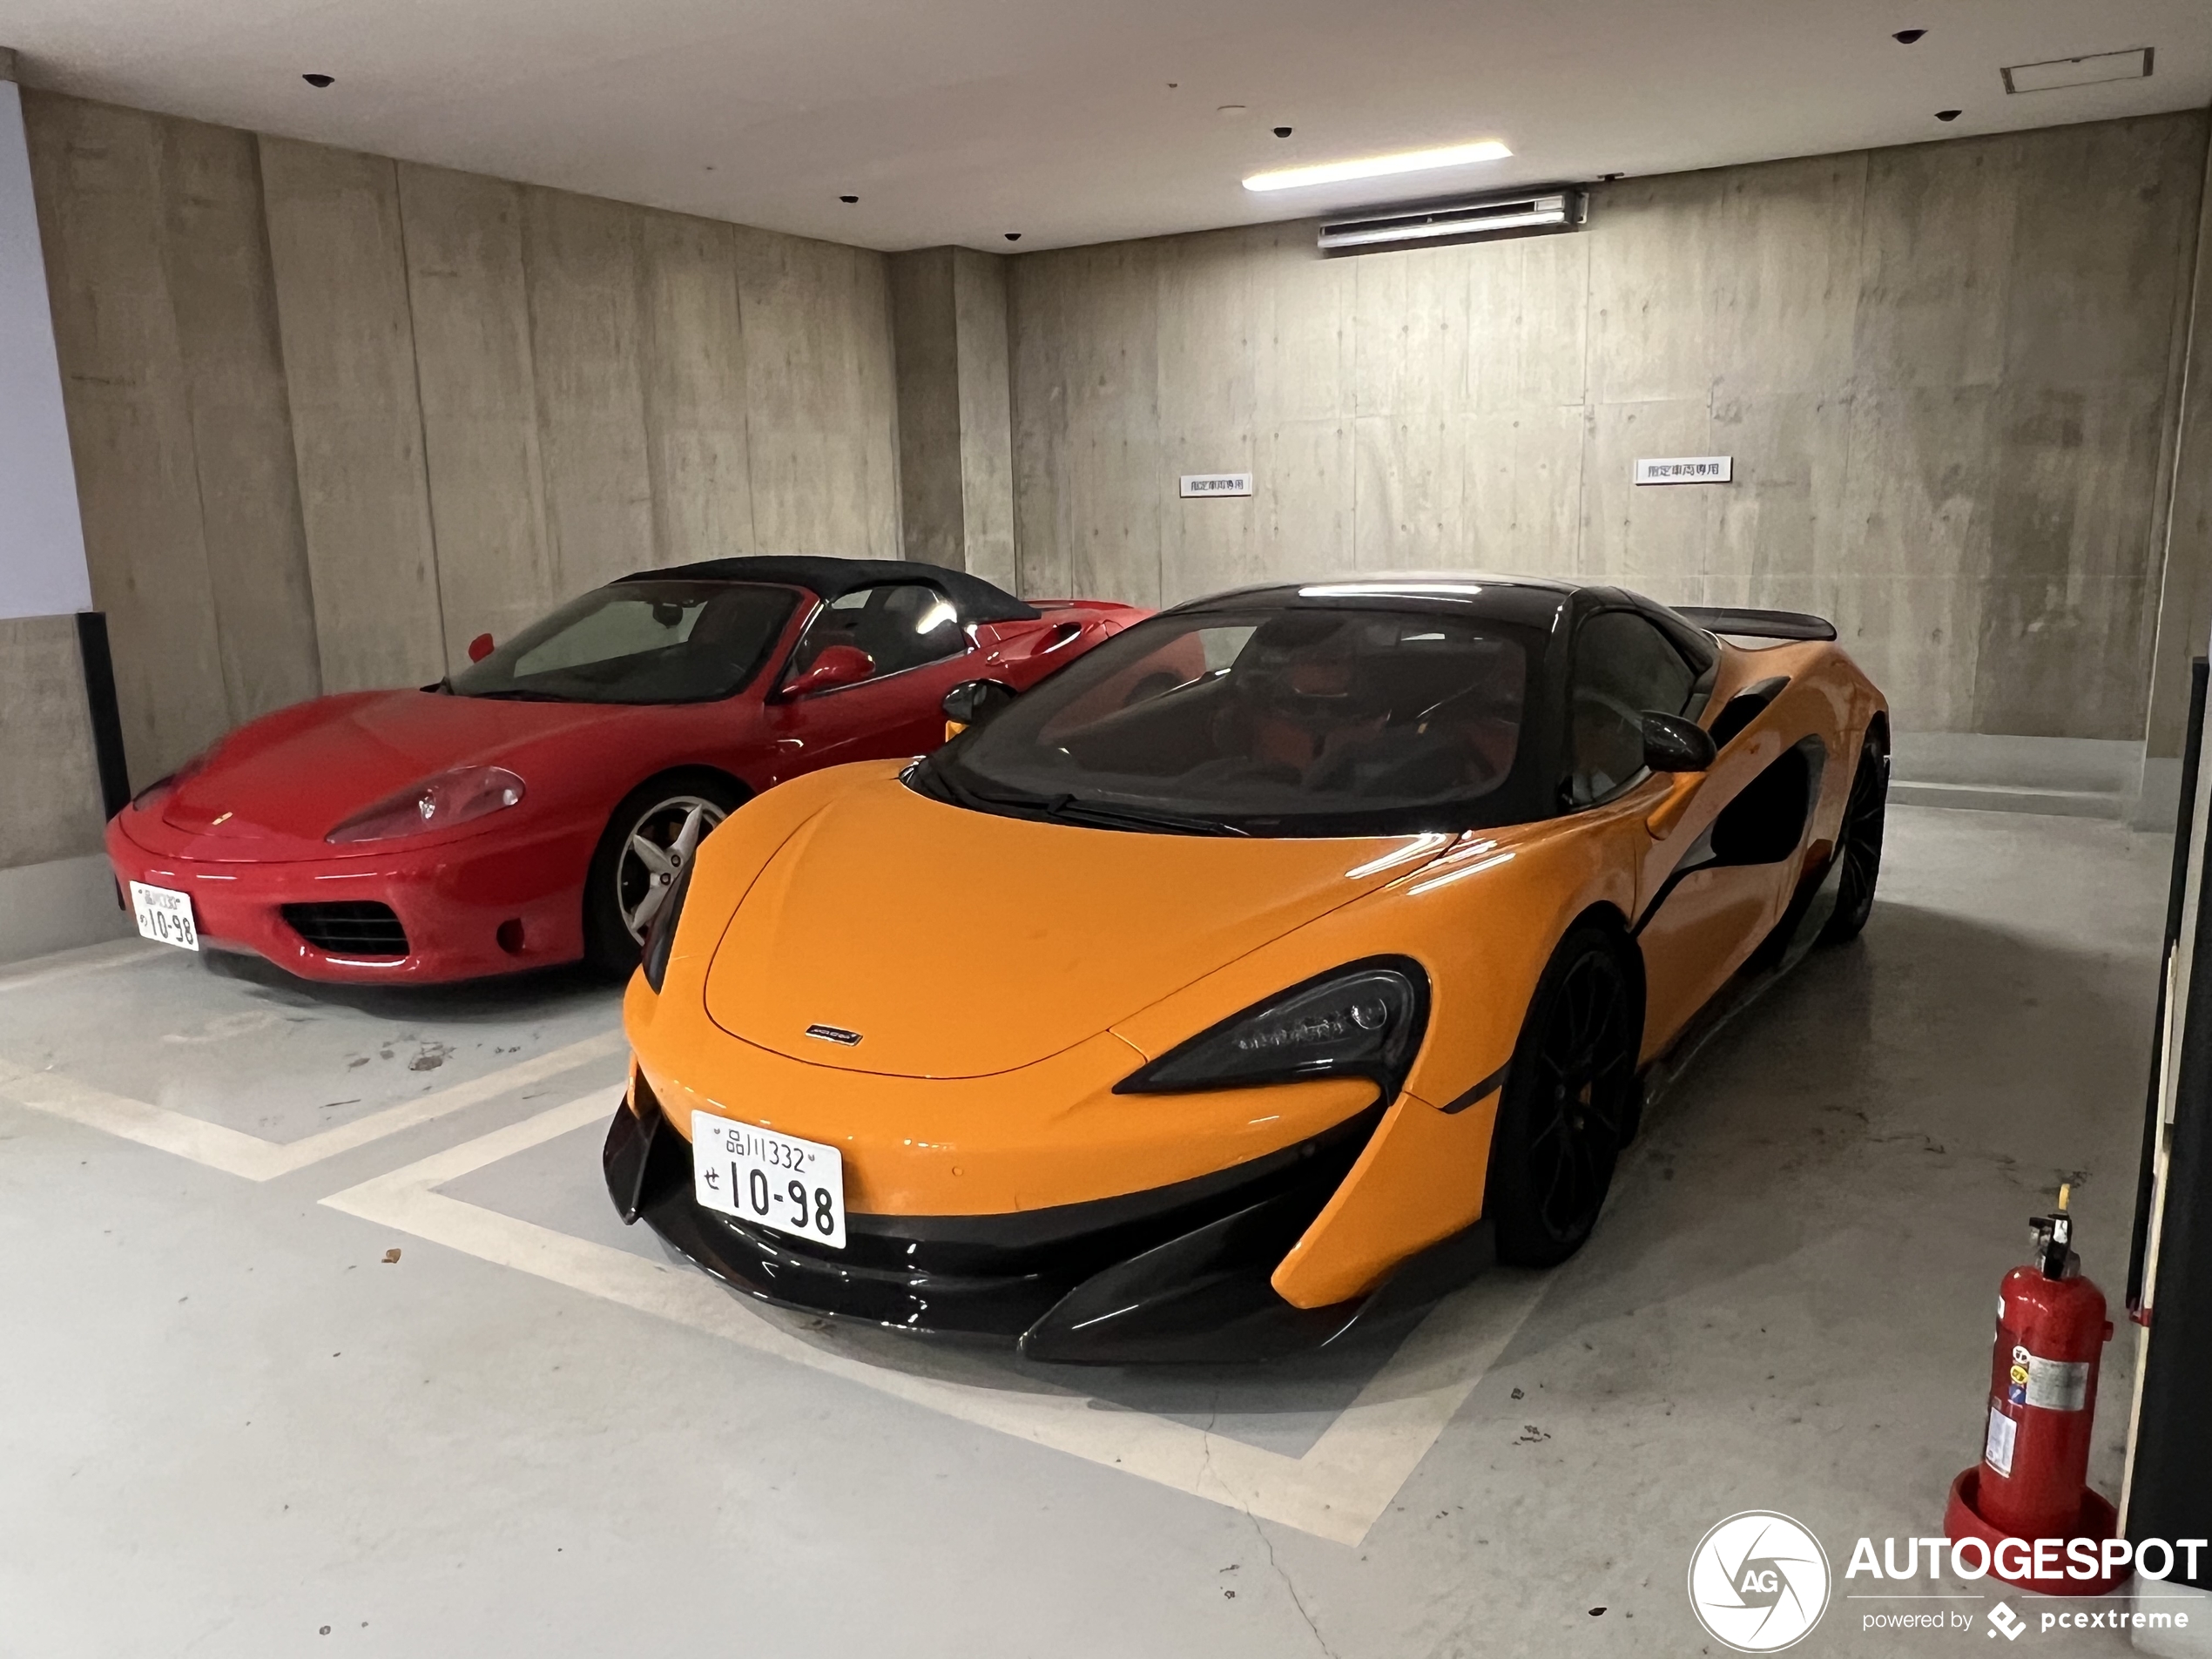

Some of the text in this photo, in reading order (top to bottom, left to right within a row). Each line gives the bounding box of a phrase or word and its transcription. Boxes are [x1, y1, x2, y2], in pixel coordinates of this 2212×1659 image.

[149, 908, 193, 945] 10-98
[726, 1129, 806, 1173] 品川332
[704, 1161, 834, 1236] せ 10-98
